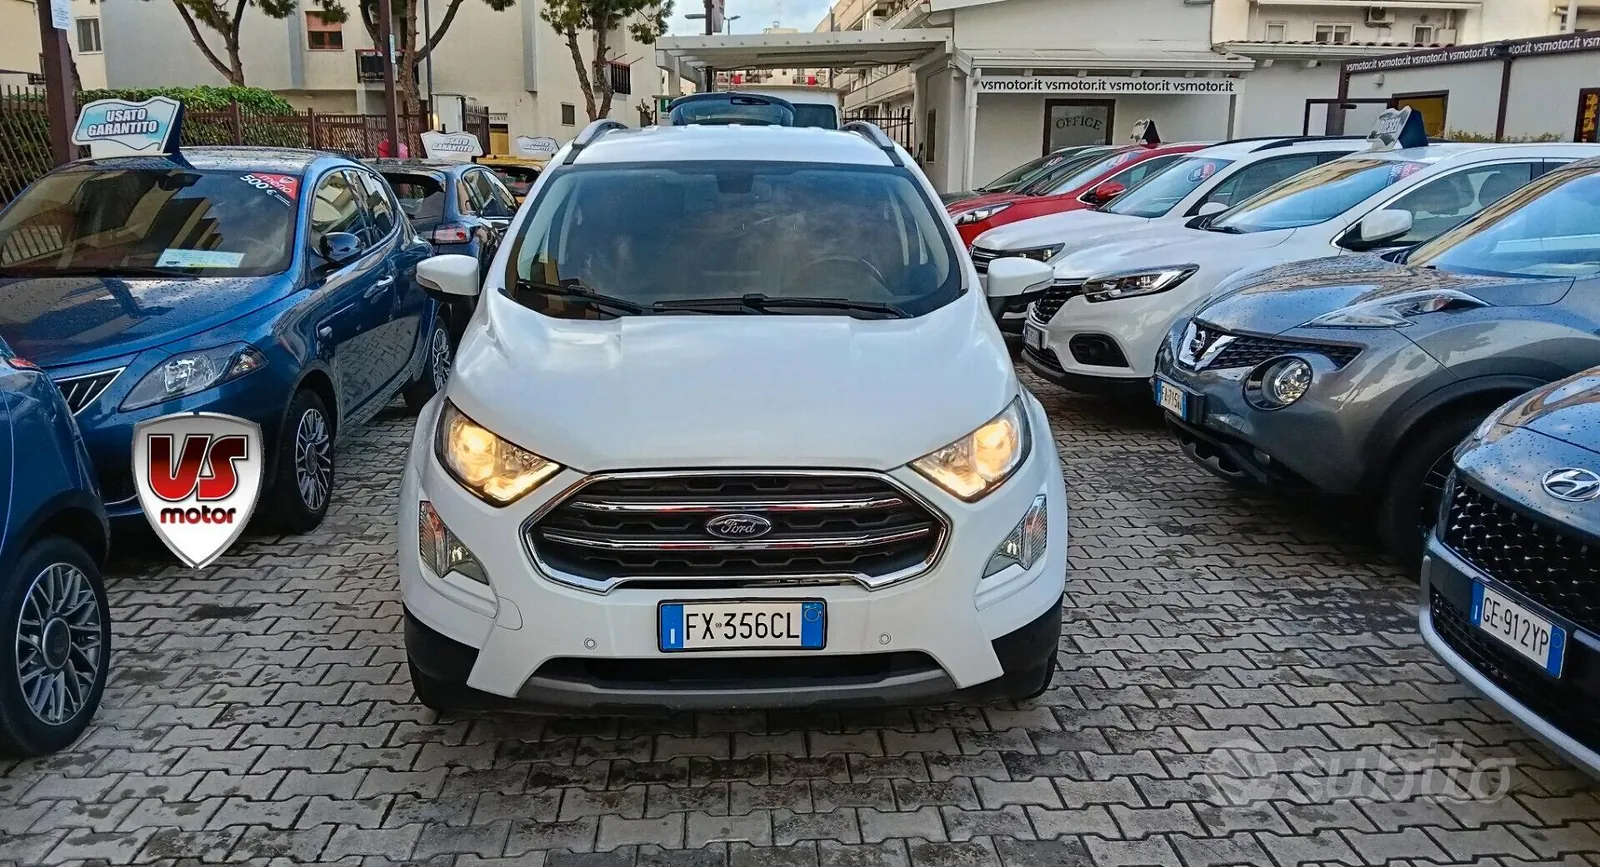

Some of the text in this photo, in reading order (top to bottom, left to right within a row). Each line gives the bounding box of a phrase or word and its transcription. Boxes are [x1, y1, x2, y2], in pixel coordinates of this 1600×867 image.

[1346, 60, 1377, 72] vsmotor.it
[1377, 54, 1410, 68] vsmotor.it
[1412, 51, 1447, 65] vsmotor.it
[1449, 45, 1487, 60] vsmotor.it
[1533, 36, 1580, 52] vsmotor.it
[981, 78, 1234, 92] vsmotor.it vsmotor.it vsmotor.it vsmotor.it
[106, 108, 147, 122] USATO
[87, 119, 158, 137] GARANTITO
[1056, 116, 1102, 130] OFFICE
[718, 518, 756, 533] Ford
